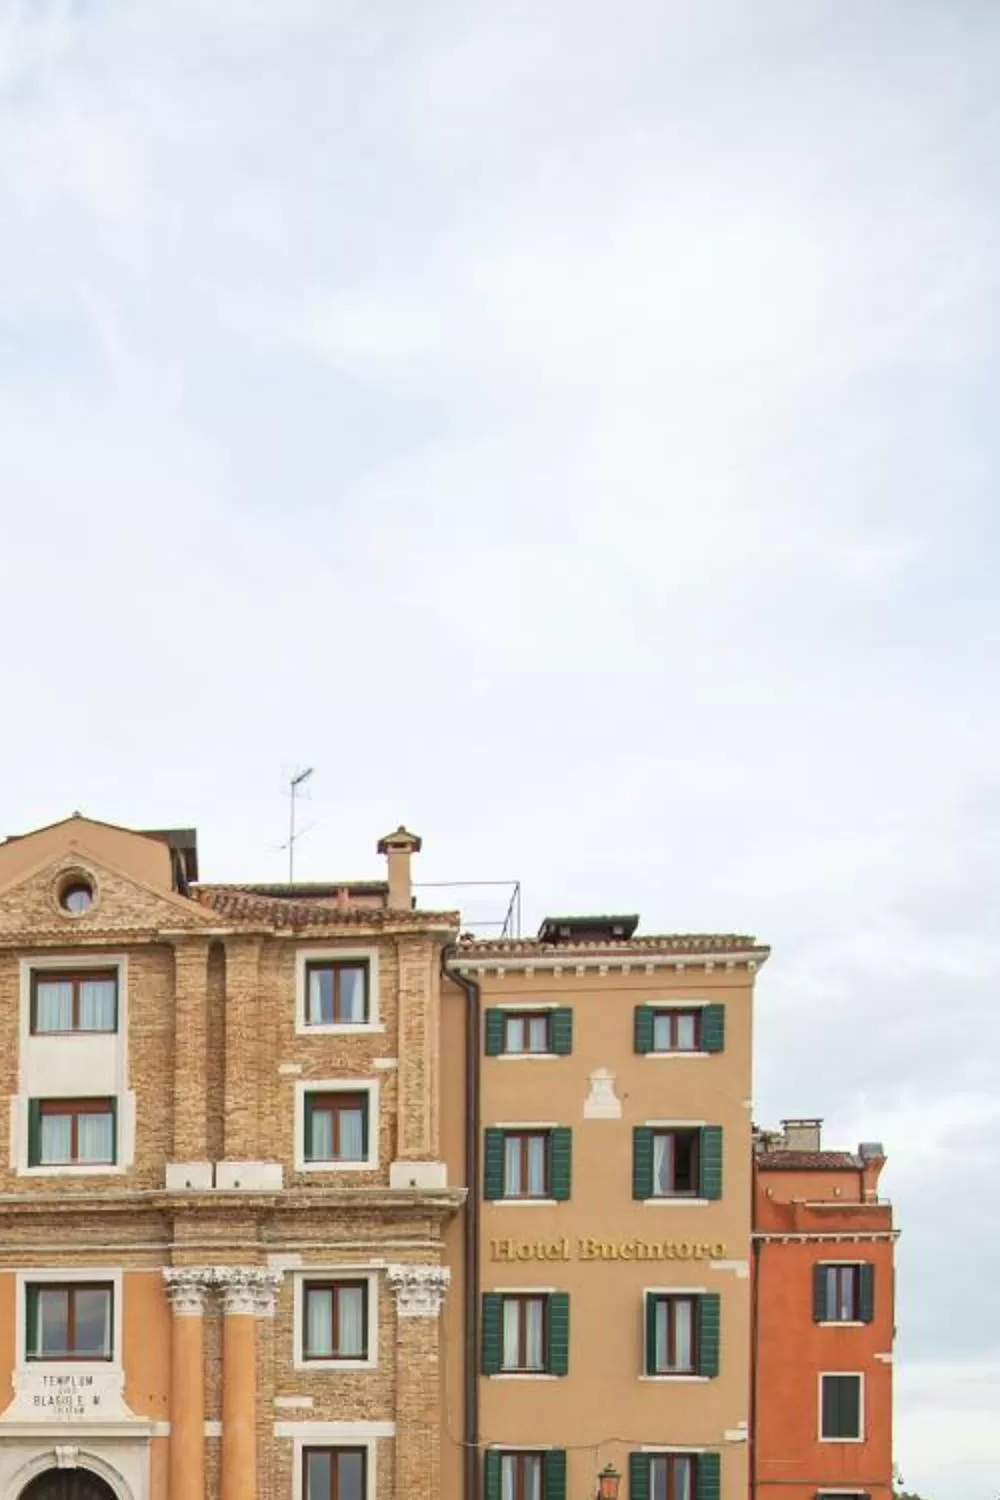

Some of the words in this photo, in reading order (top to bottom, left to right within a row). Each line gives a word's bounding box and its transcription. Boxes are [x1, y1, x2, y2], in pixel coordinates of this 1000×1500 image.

[490, 1237, 571, 1262] Hotel
[578, 1237, 728, 1261] Bucintoro
[42, 1375, 94, 1387] TEMPLUM
